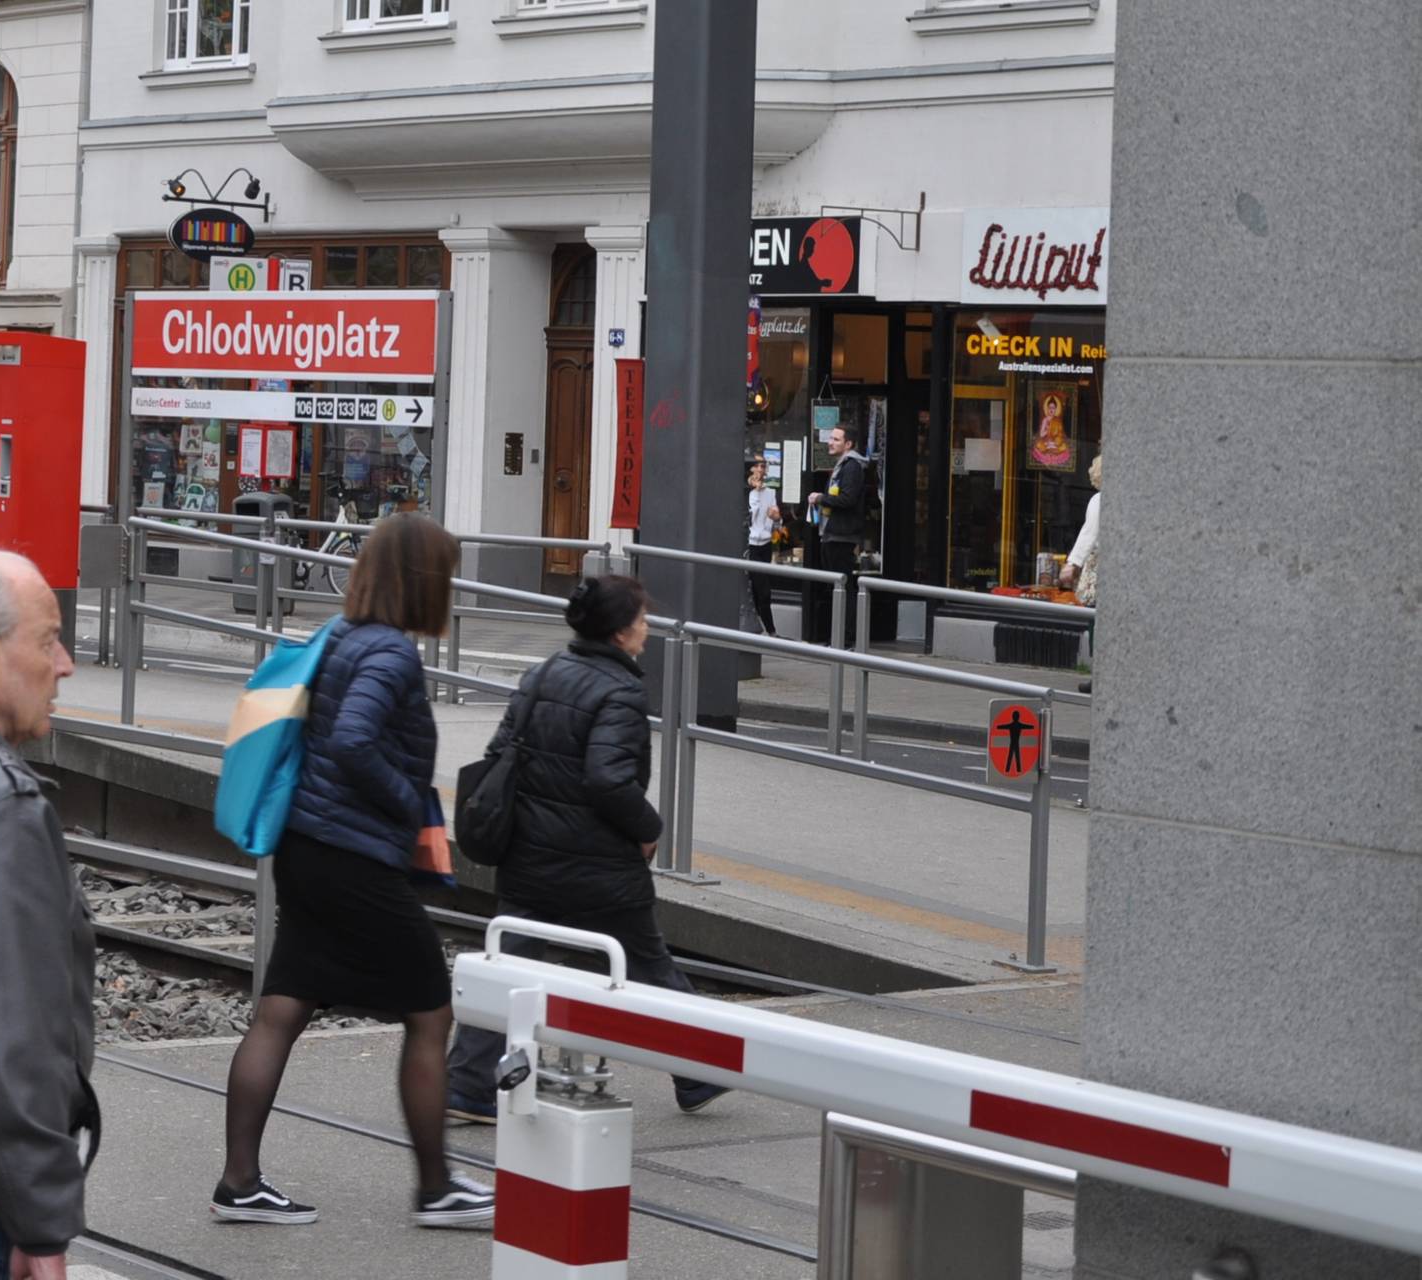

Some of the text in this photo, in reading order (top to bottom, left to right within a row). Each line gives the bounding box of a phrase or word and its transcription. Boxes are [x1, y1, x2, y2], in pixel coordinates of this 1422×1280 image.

[749, 228, 791, 266] EN
[969, 222, 1107, 301] Lilliput
[162, 309, 401, 369] Chlodwigplatz
[966, 334, 1041, 357] CHECK
[1050, 337, 1074, 358] IN
[998, 361, 1094, 374] Australienspezialist.com
[296, 400, 313, 415] 106
[317, 401, 334, 416] 132
[338, 401, 355, 417] 133
[359, 403, 377, 417] 142
[622, 369, 635, 506] TEELADEN
